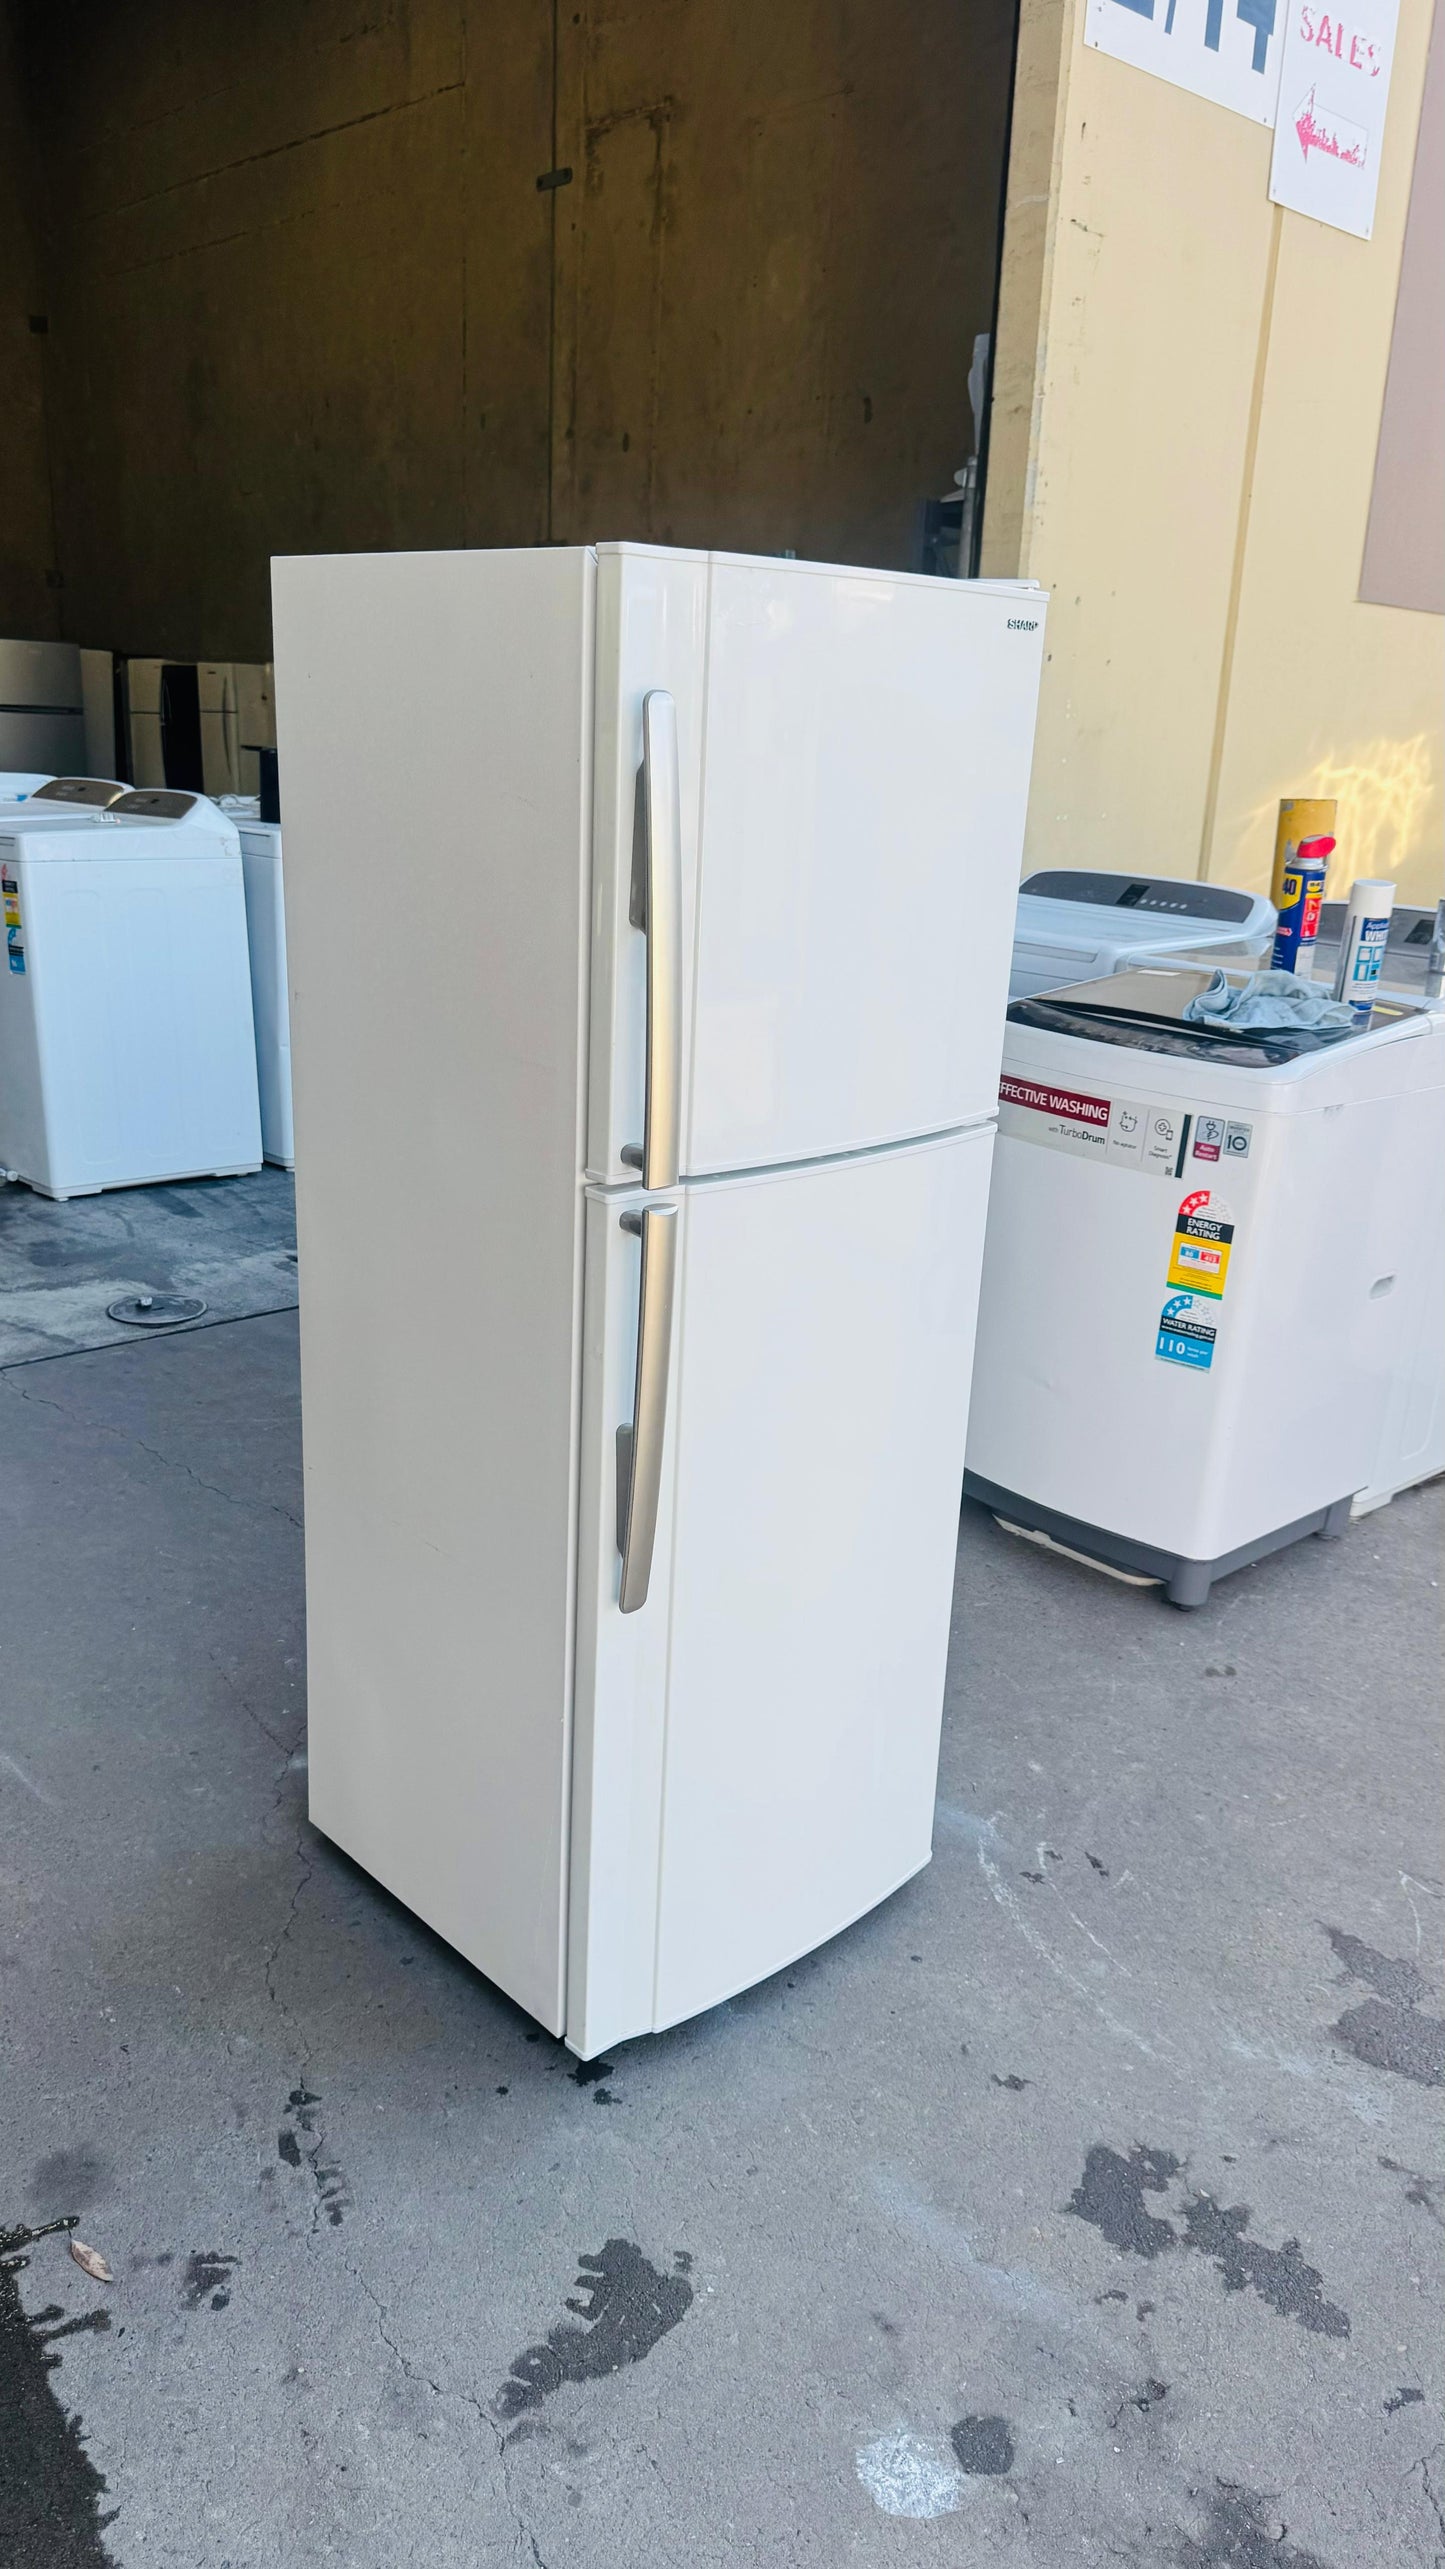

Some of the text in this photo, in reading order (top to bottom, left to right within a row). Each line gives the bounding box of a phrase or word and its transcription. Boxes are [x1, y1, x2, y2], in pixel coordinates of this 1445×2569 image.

[1300, 6, 1381, 77] SALES
[999, 1081, 1109, 1121] FFECTIVE WASHING
[1059, 1123, 1105, 1144] TurboDrum
[1186, 1226, 1221, 1240] RATING
[1187, 1218, 1223, 1232] ENERGY
[1162, 1317, 1215, 1337] WATER RATING
[1159, 1336, 1186, 1355] 110
